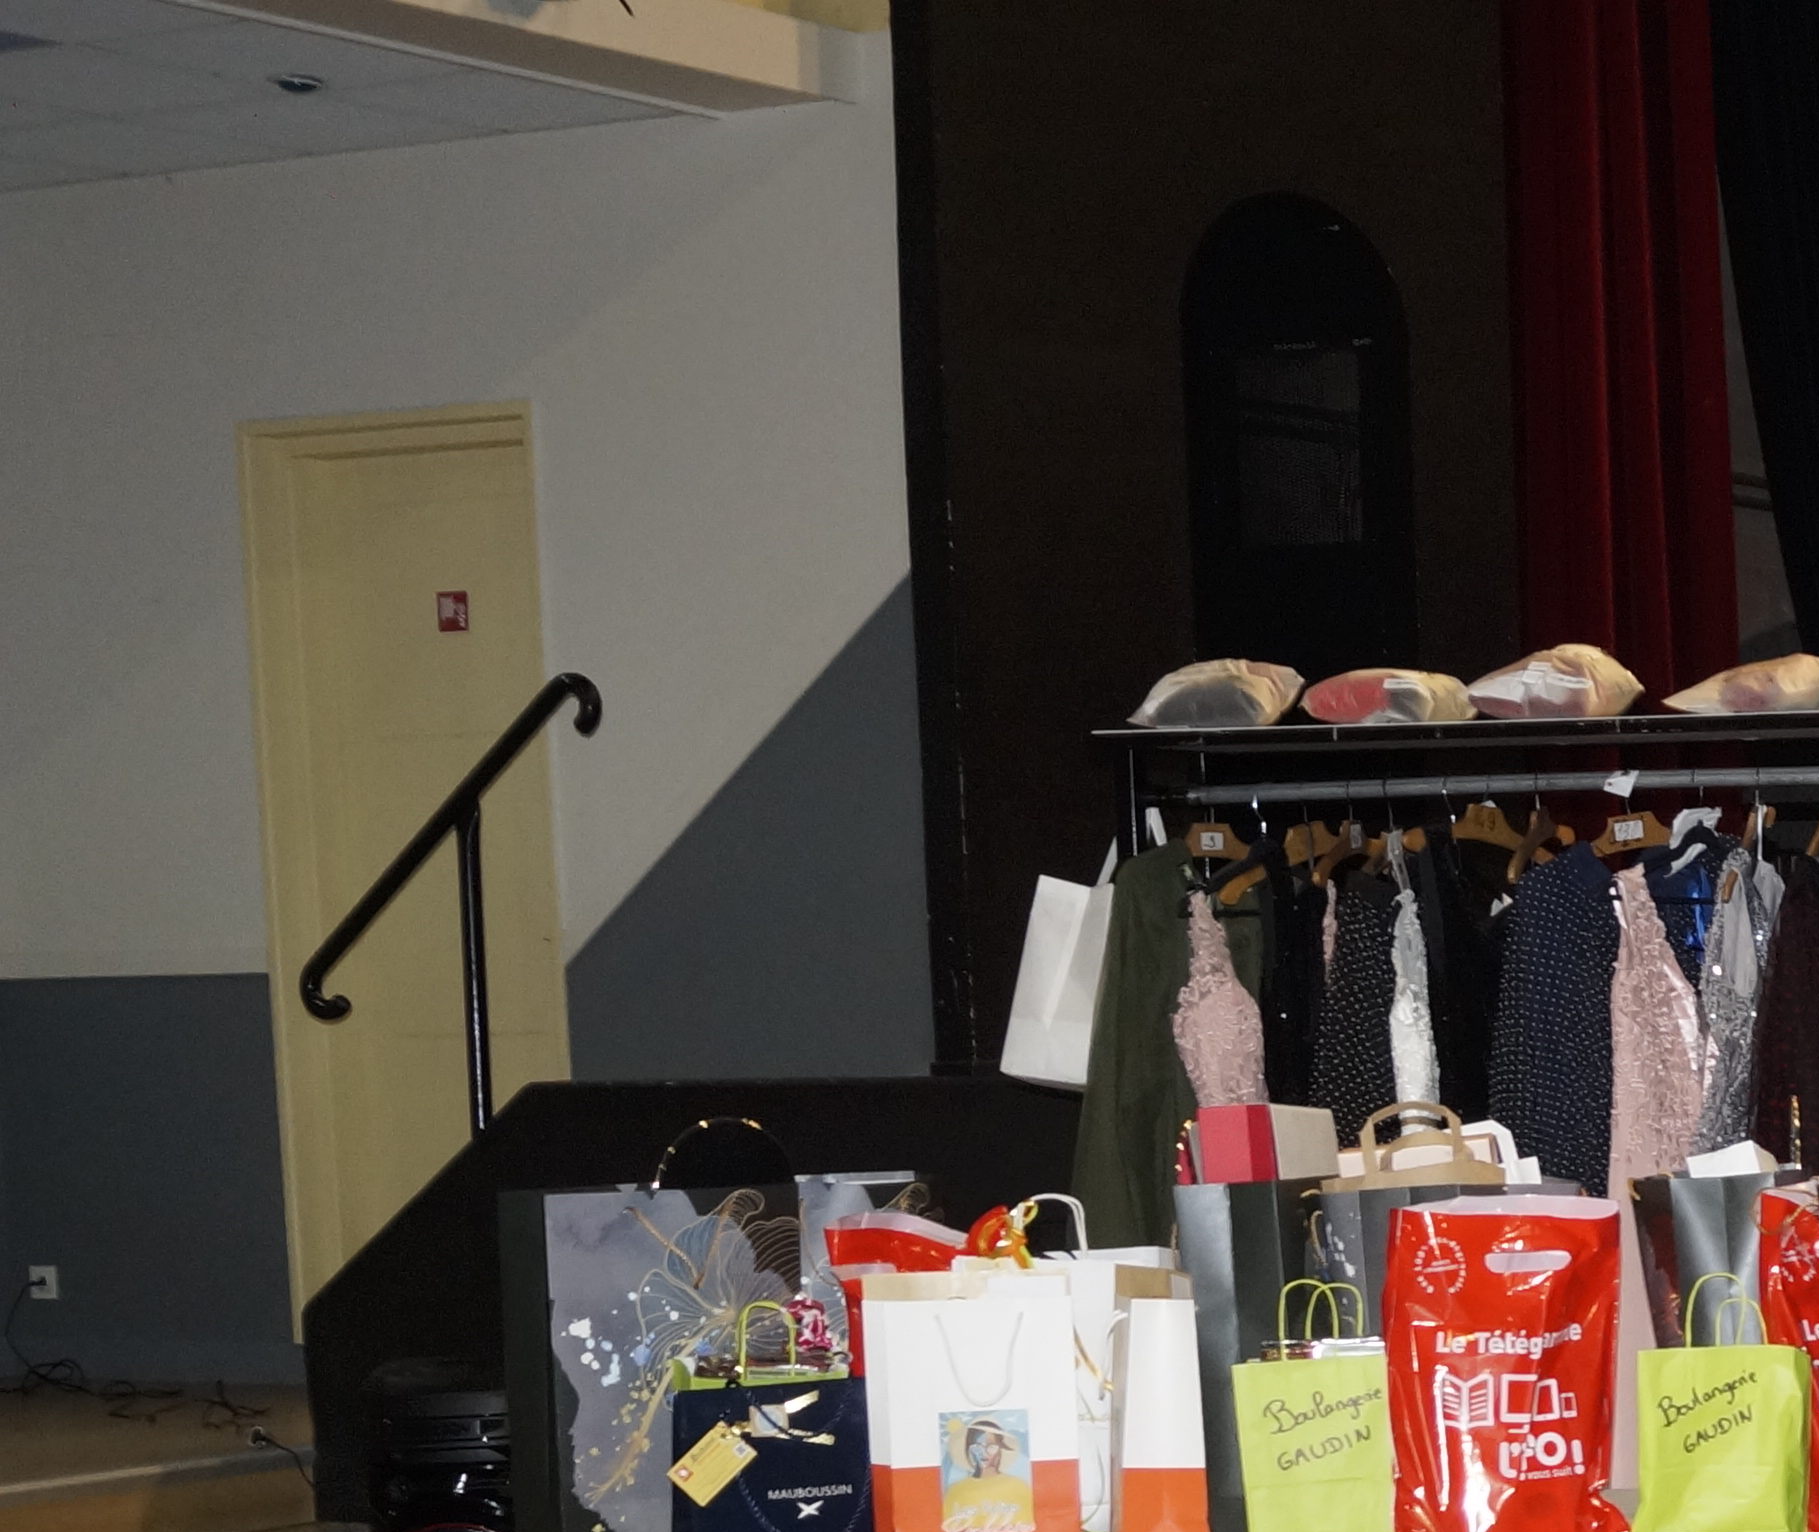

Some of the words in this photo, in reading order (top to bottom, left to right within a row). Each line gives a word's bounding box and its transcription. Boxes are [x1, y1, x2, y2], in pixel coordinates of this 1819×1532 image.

[1435, 1331, 1467, 1354] Le
[1263, 1388, 1383, 1434] Boulangerie
[1656, 1369, 1758, 1428] Boulangerie
[1277, 1425, 1371, 1471] GAUDIN
[1683, 1403, 1753, 1454] GAUDIN
[767, 1484, 853, 1500] MAUBOUSSIN
